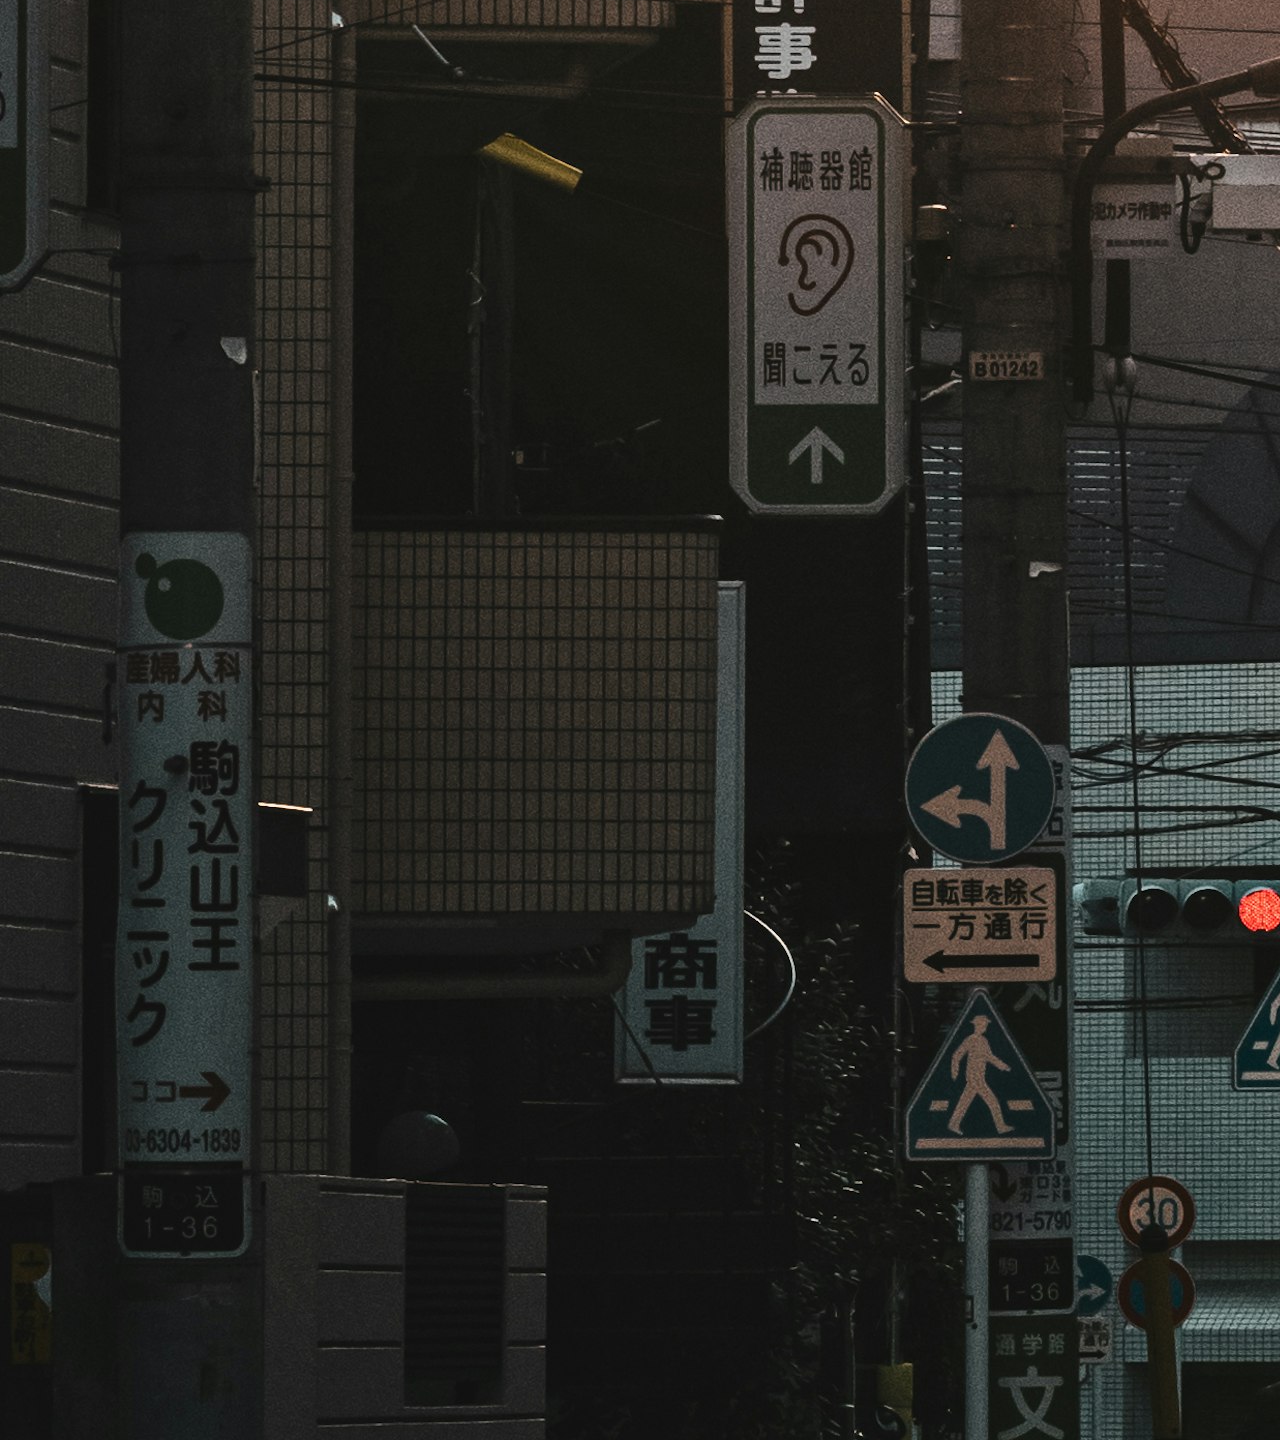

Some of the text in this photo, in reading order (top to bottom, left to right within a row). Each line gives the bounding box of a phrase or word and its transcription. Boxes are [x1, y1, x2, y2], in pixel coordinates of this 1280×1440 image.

[761, 147, 874, 192] 補聴器館
[1091, 202, 1172, 221] 犯カメラ作動中
[763, 342, 871, 387] 聞こえる
[127, 652, 241, 684] 産婦人科
[189, 739, 240, 971] 駒込山王
[911, 878, 1048, 907] 自転車を除く
[127, 780, 170, 1047] クリニック
[912, 912, 1049, 941] 一方通行
[645, 932, 718, 1052] 商事
[131, 1081, 177, 1102] ココ
[126, 1128, 241, 1154] 03-6304-1839
[144, 1216, 220, 1240] 1-36
[1136, 1197, 1178, 1230] 30
[1002, 1281, 1061, 1302] 1-36
[995, 1332, 1065, 1357] 通学路
